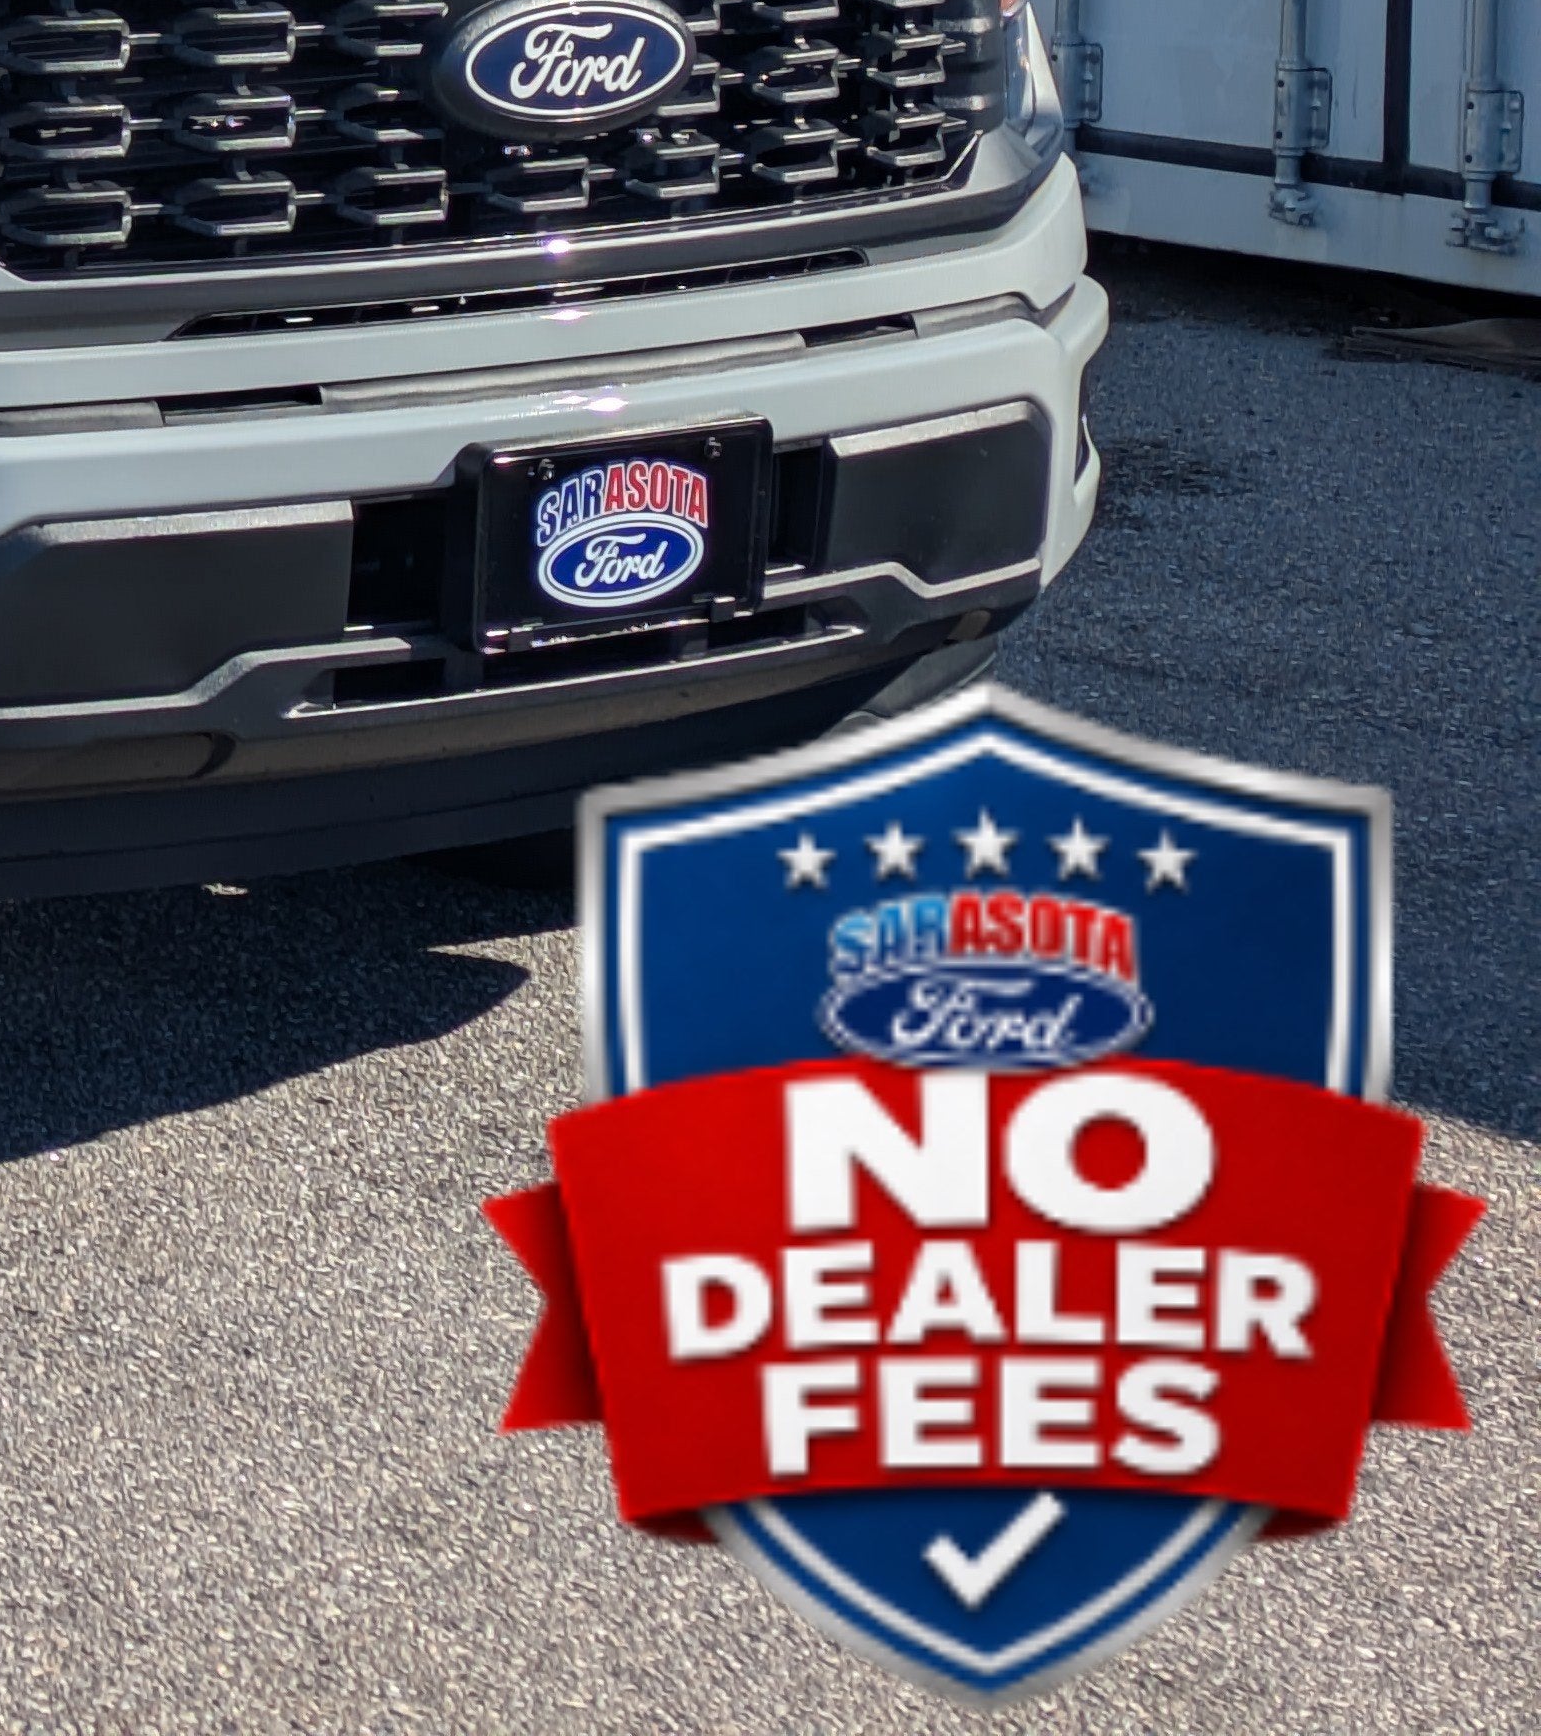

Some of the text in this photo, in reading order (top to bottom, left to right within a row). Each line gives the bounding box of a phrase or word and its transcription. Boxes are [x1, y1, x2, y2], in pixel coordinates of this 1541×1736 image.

[509, 22, 646, 99] Ford
[536, 460, 708, 548] SARASOTA
[574, 532, 669, 588] Ford
